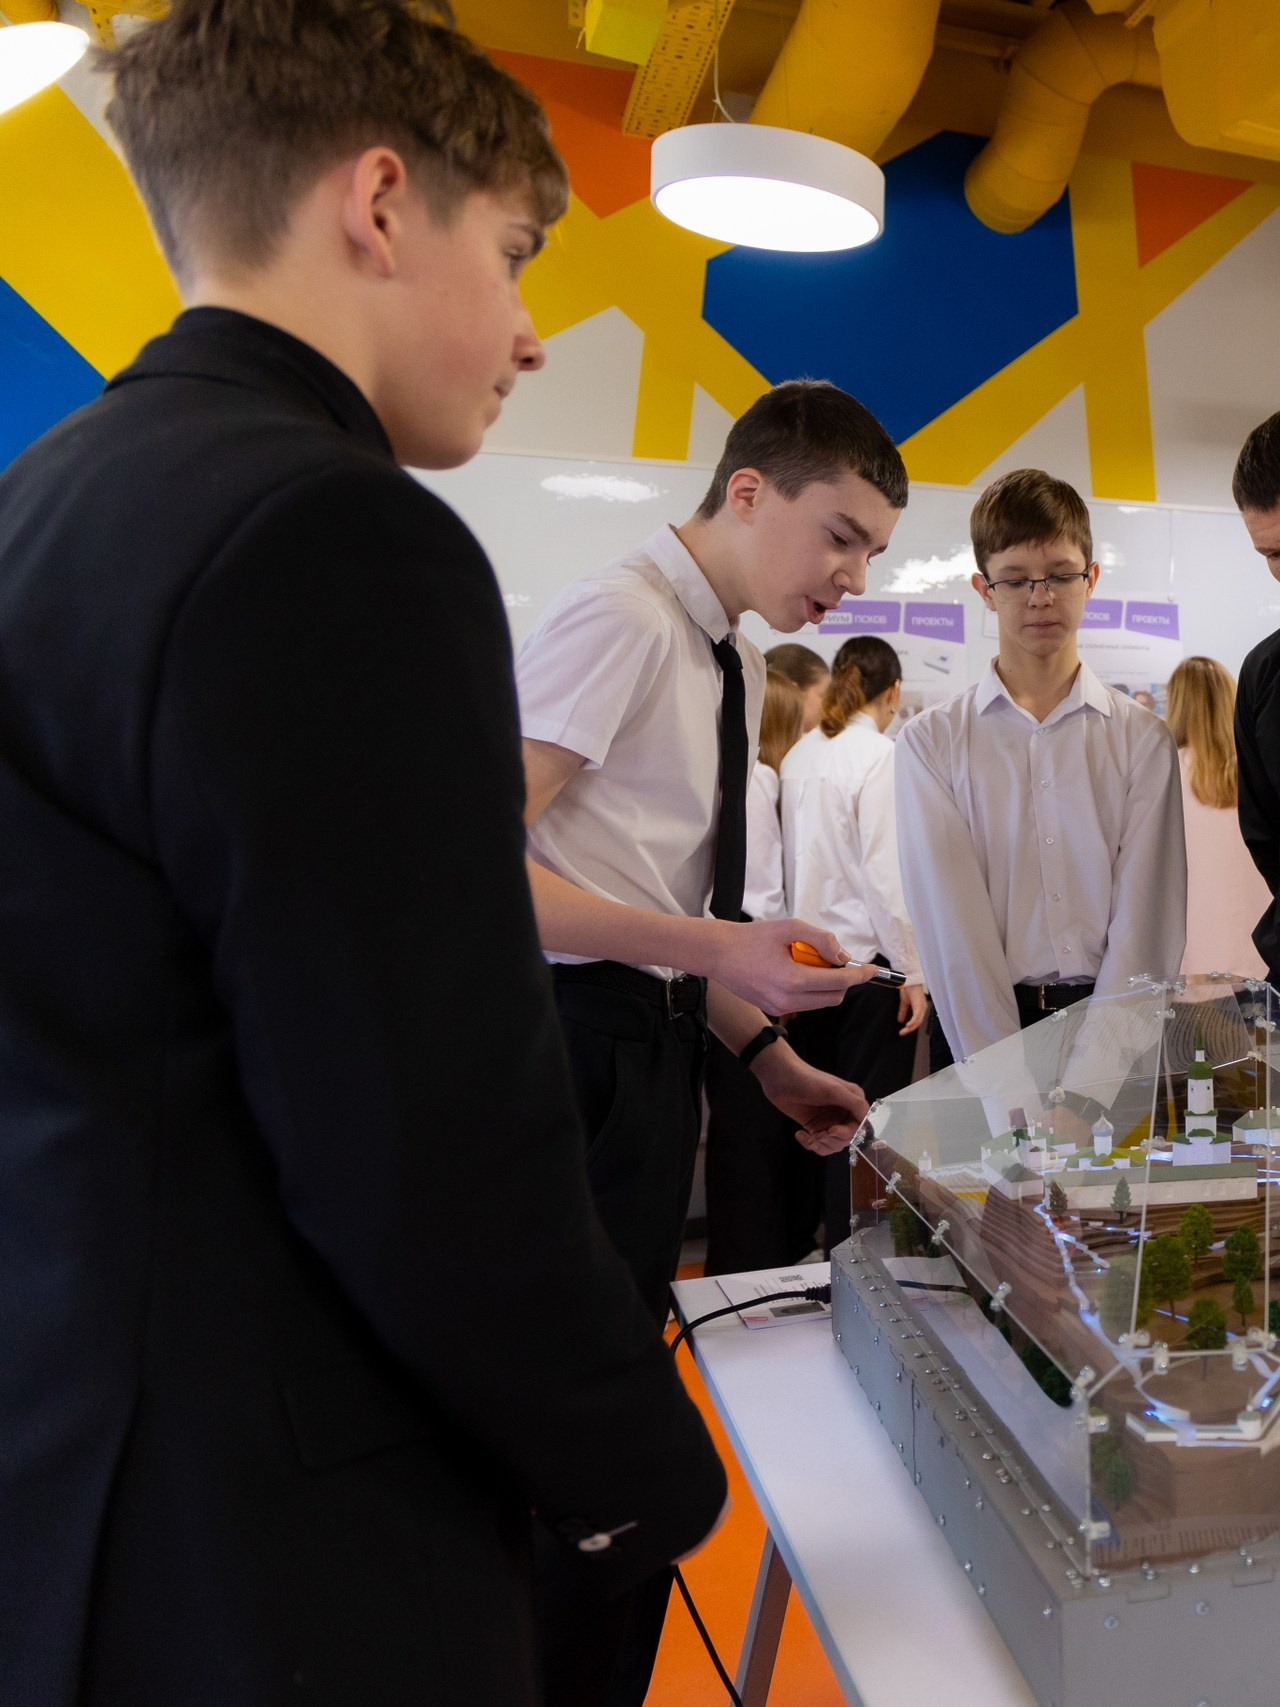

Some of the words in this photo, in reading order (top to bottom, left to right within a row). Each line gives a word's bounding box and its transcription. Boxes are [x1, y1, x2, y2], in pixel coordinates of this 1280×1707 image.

[854, 614, 887, 625] ПСКОВ
[911, 615, 954, 626] ПРОЕКТЫ
[1131, 614, 1170, 625] ПРОЕКТЫ
